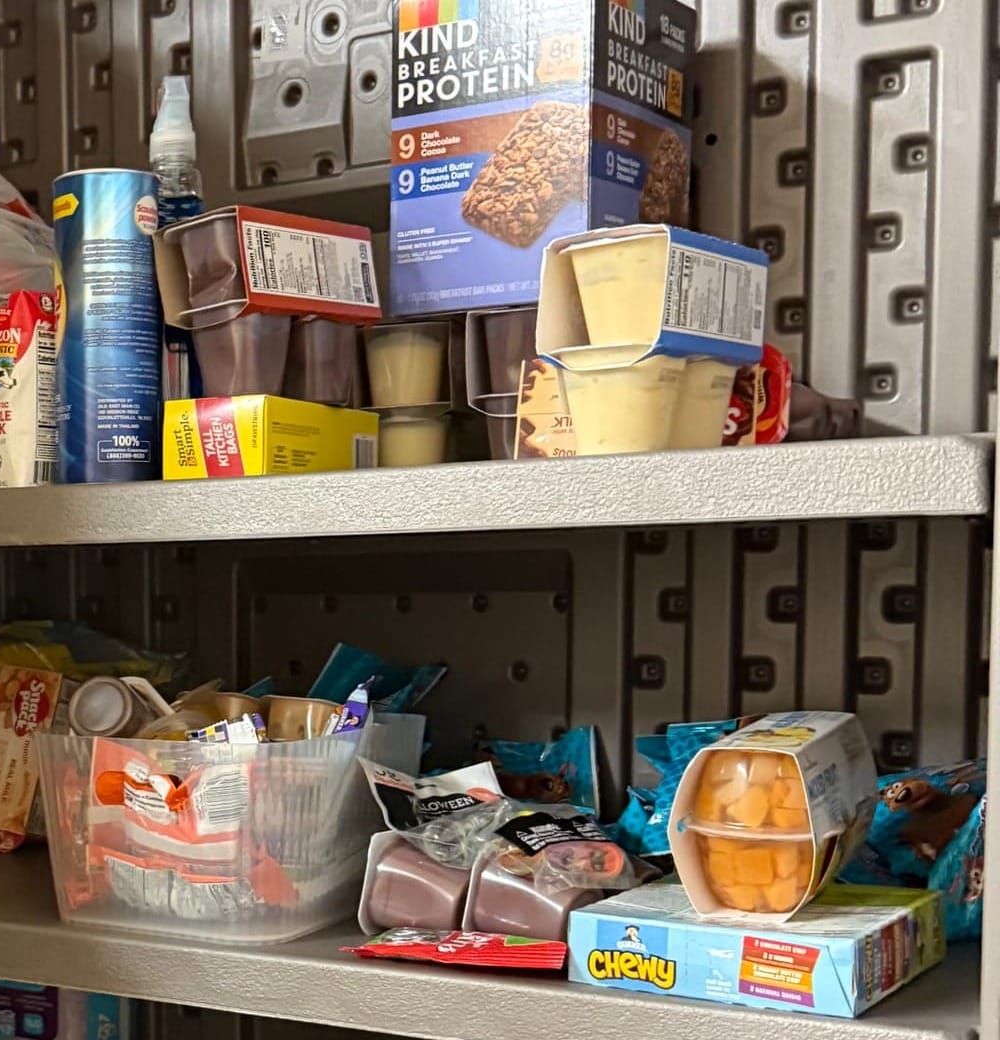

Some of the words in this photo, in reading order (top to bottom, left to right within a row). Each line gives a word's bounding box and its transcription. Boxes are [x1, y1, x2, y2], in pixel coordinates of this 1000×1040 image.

[398, 19, 479, 59] KIND
[608, 4, 646, 46] KIND
[398, 40, 538, 81] BREAKFAST
[608, 38, 668, 81] BREAKFAST
[398, 60, 535, 108] PROTEIN
[608, 60, 667, 110] PROTEIN
[421, 131, 440, 141] Dark
[607, 114, 615, 139] 9
[399, 134, 415, 158] 9
[421, 136, 461, 149] Chocolate
[421, 147, 447, 157] Cocoa
[421, 165, 448, 177] Peanut
[449, 162, 474, 172] Butter
[421, 173, 450, 184] Banana
[451, 171, 471, 180] Dark
[606, 151, 614, 176] 9
[398, 170, 415, 194] 9
[421, 181, 460, 193] Chocolate
[263, 230, 271, 248] 100
[249, 252, 258, 288] Nutrition
[269, 258, 278, 289] Calories
[664, 279, 673, 325] Nutrition
[679, 288, 688, 327] Calories
[684, 255, 692, 278] 110
[112, 435, 140, 447] 100%
[173, 429, 188, 467] Smart
[203, 432, 217, 457] TALL
[214, 417, 228, 467] KITCHEN
[225, 423, 238, 455] BAGS
[28, 680, 45, 733] Snack
